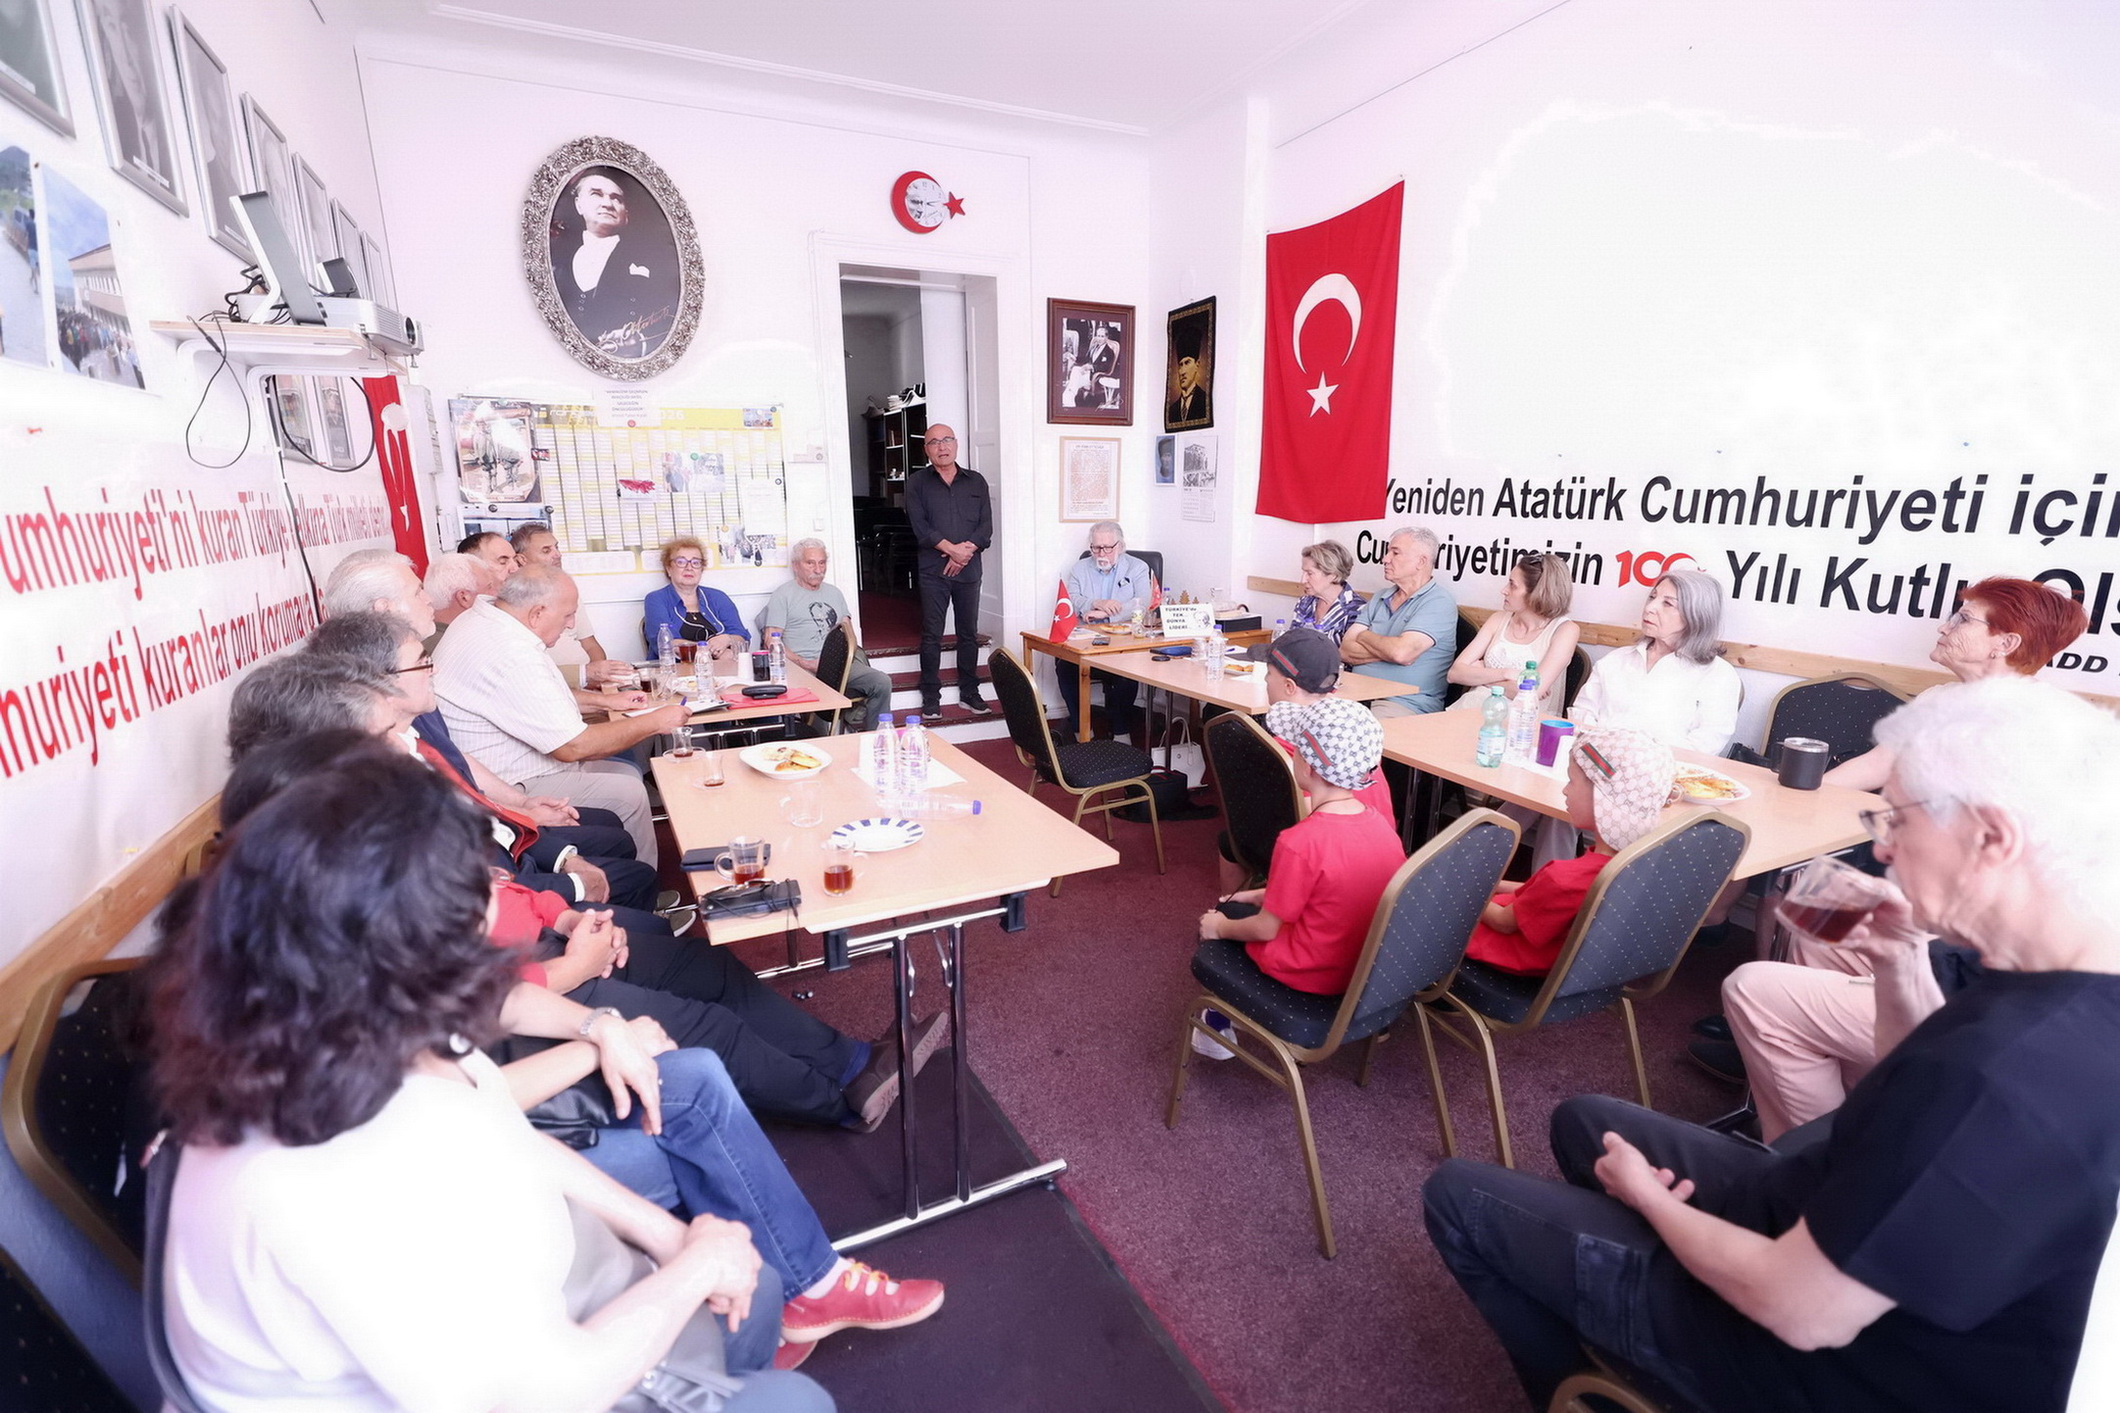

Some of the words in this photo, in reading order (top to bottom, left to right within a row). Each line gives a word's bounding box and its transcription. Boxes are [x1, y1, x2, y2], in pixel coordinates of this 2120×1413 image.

[0, 485, 199, 601] umhuriyeti'ni
[188, 489, 248, 565] kuran
[1492, 475, 1628, 522] Atatürk
[1640, 473, 1989, 546] Cumhuriyeti
[1356, 530, 1603, 586] Curiyetiin
[1725, 549, 1801, 605] Yılı
[0, 629, 140, 778] huriyeti
[132, 608, 231, 712] kuranlar
[230, 612, 259, 670] onu
[2046, 652, 2109, 674] DD
